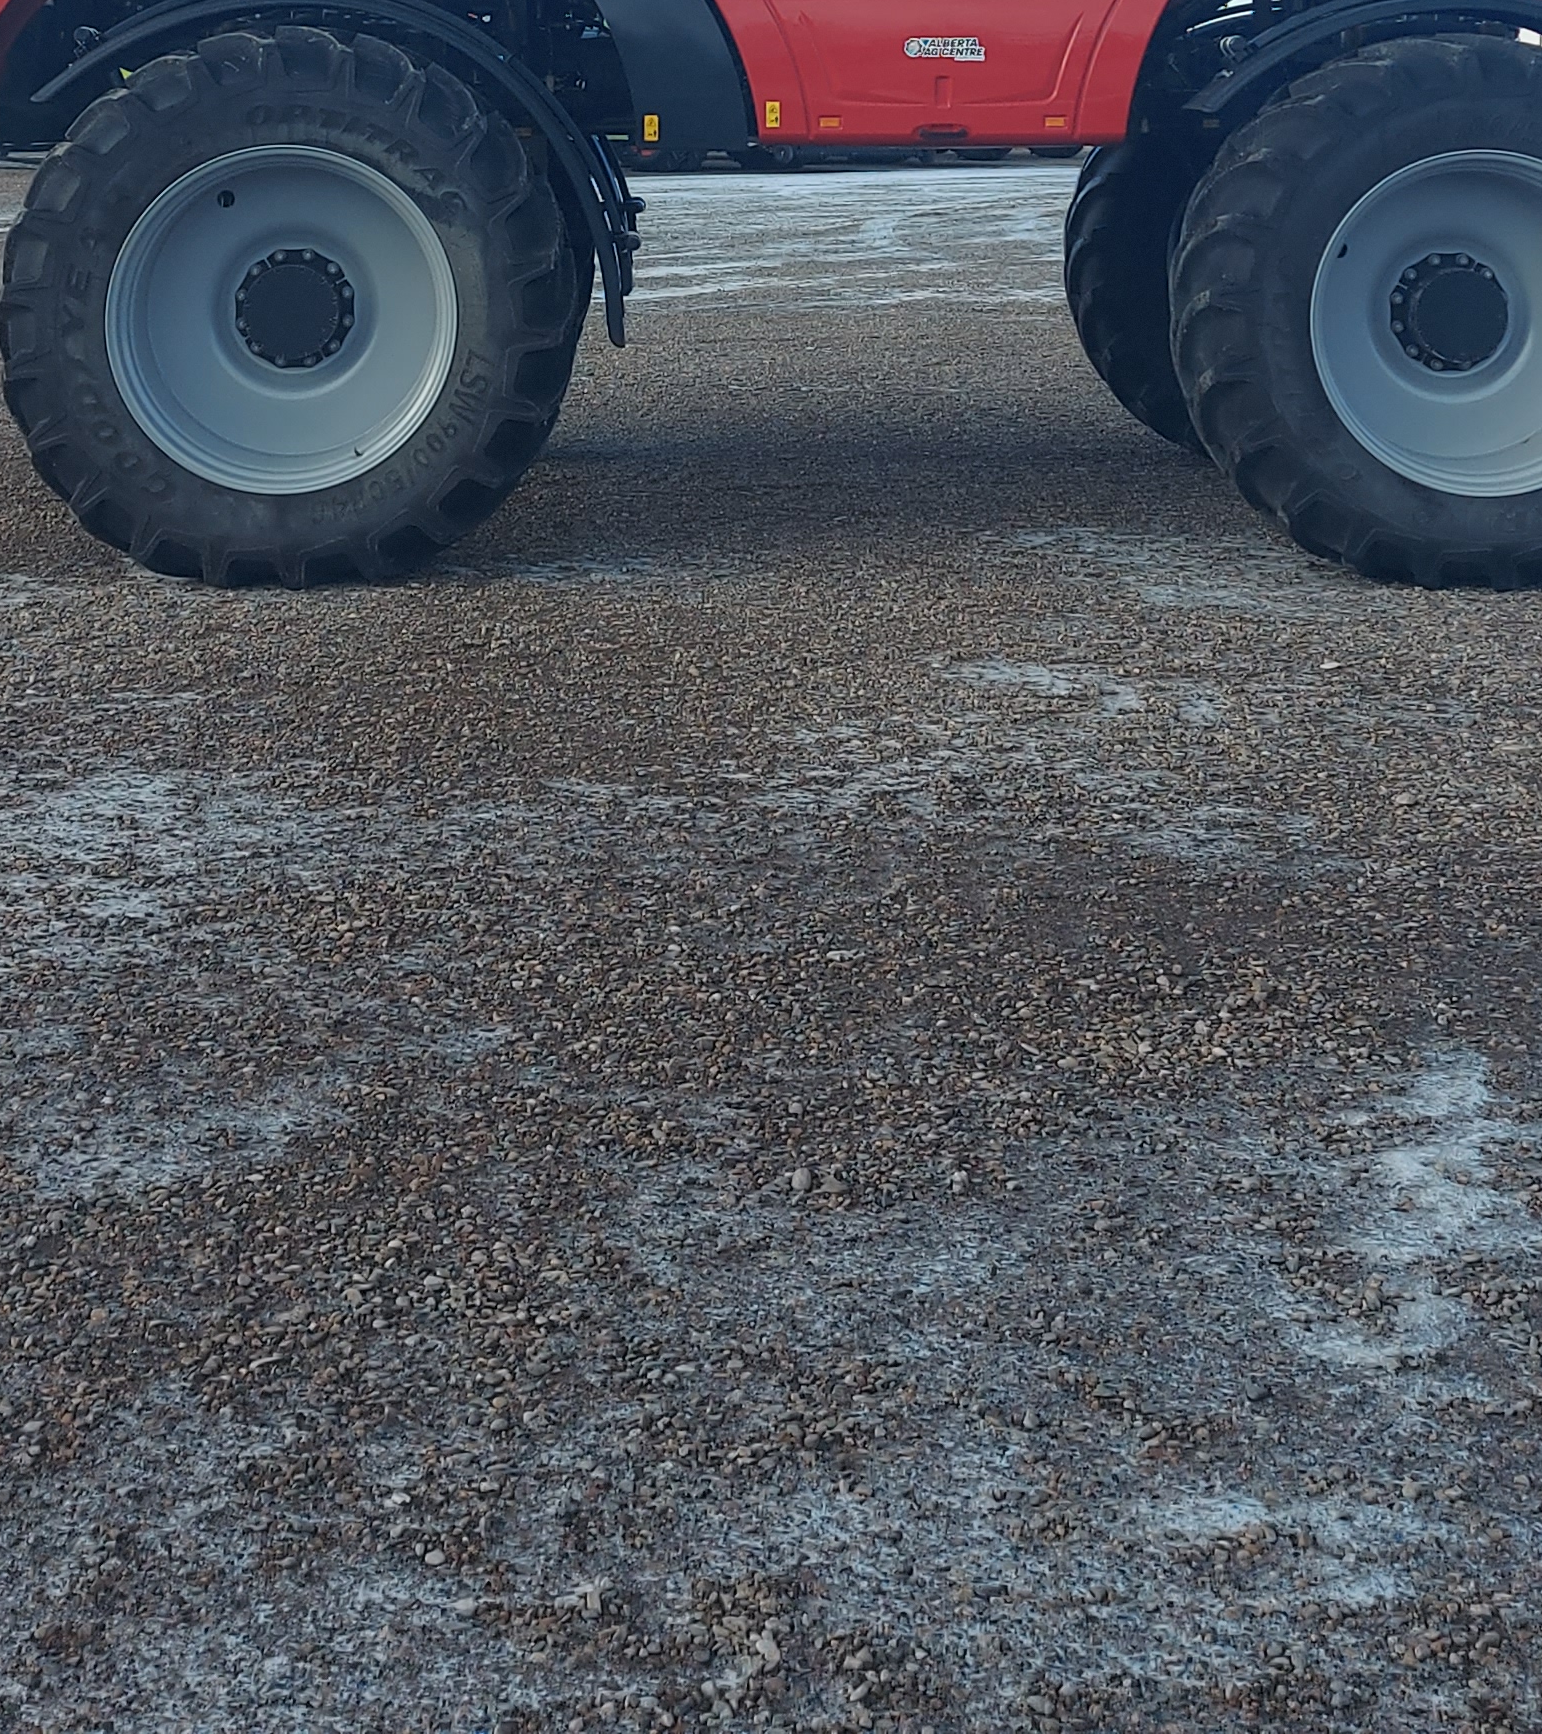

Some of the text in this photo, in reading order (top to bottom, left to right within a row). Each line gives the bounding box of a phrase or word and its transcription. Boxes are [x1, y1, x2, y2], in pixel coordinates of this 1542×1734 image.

[929, 38, 978, 48] ALBERTA
[923, 47, 983, 56] AG CENTRE
